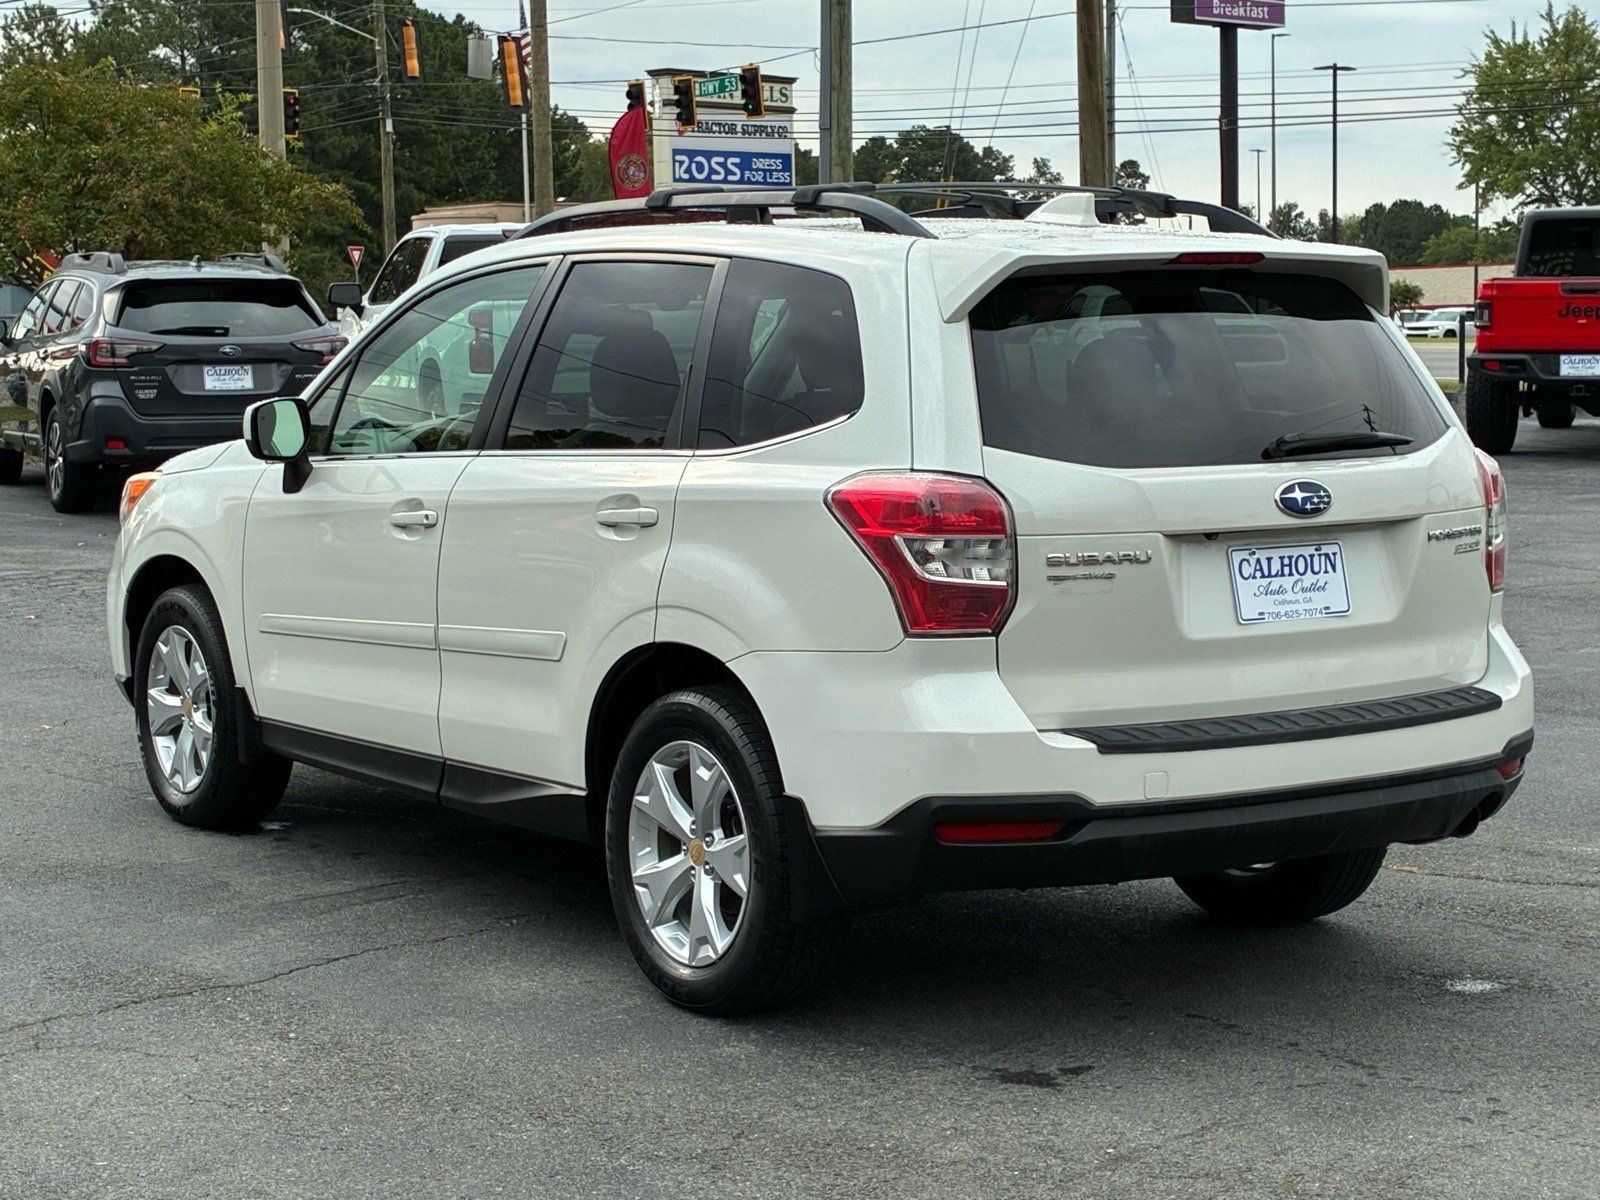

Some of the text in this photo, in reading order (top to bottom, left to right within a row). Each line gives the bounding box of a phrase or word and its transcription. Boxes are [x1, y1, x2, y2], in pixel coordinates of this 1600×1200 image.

[1213, 0, 1269, 19] Breakfast
[701, 77, 737, 95] HWY 53
[691, 121, 737, 135] RACTOR
[741, 123, 776, 137] SUPPLY
[675, 155, 741, 181] ROSS
[751, 158, 783, 170] DRESS
[744, 171, 791, 183] FOR LESS
[206, 368, 250, 377] CALHOUN
[1046, 550, 1152, 567] SUBARU
[1238, 552, 1338, 581] CALHOUN
[1253, 577, 1330, 597] Auto Outlet
[1303, 596, 1313, 604] GA
[1266, 607, 1324, 620] 706-625-7074
